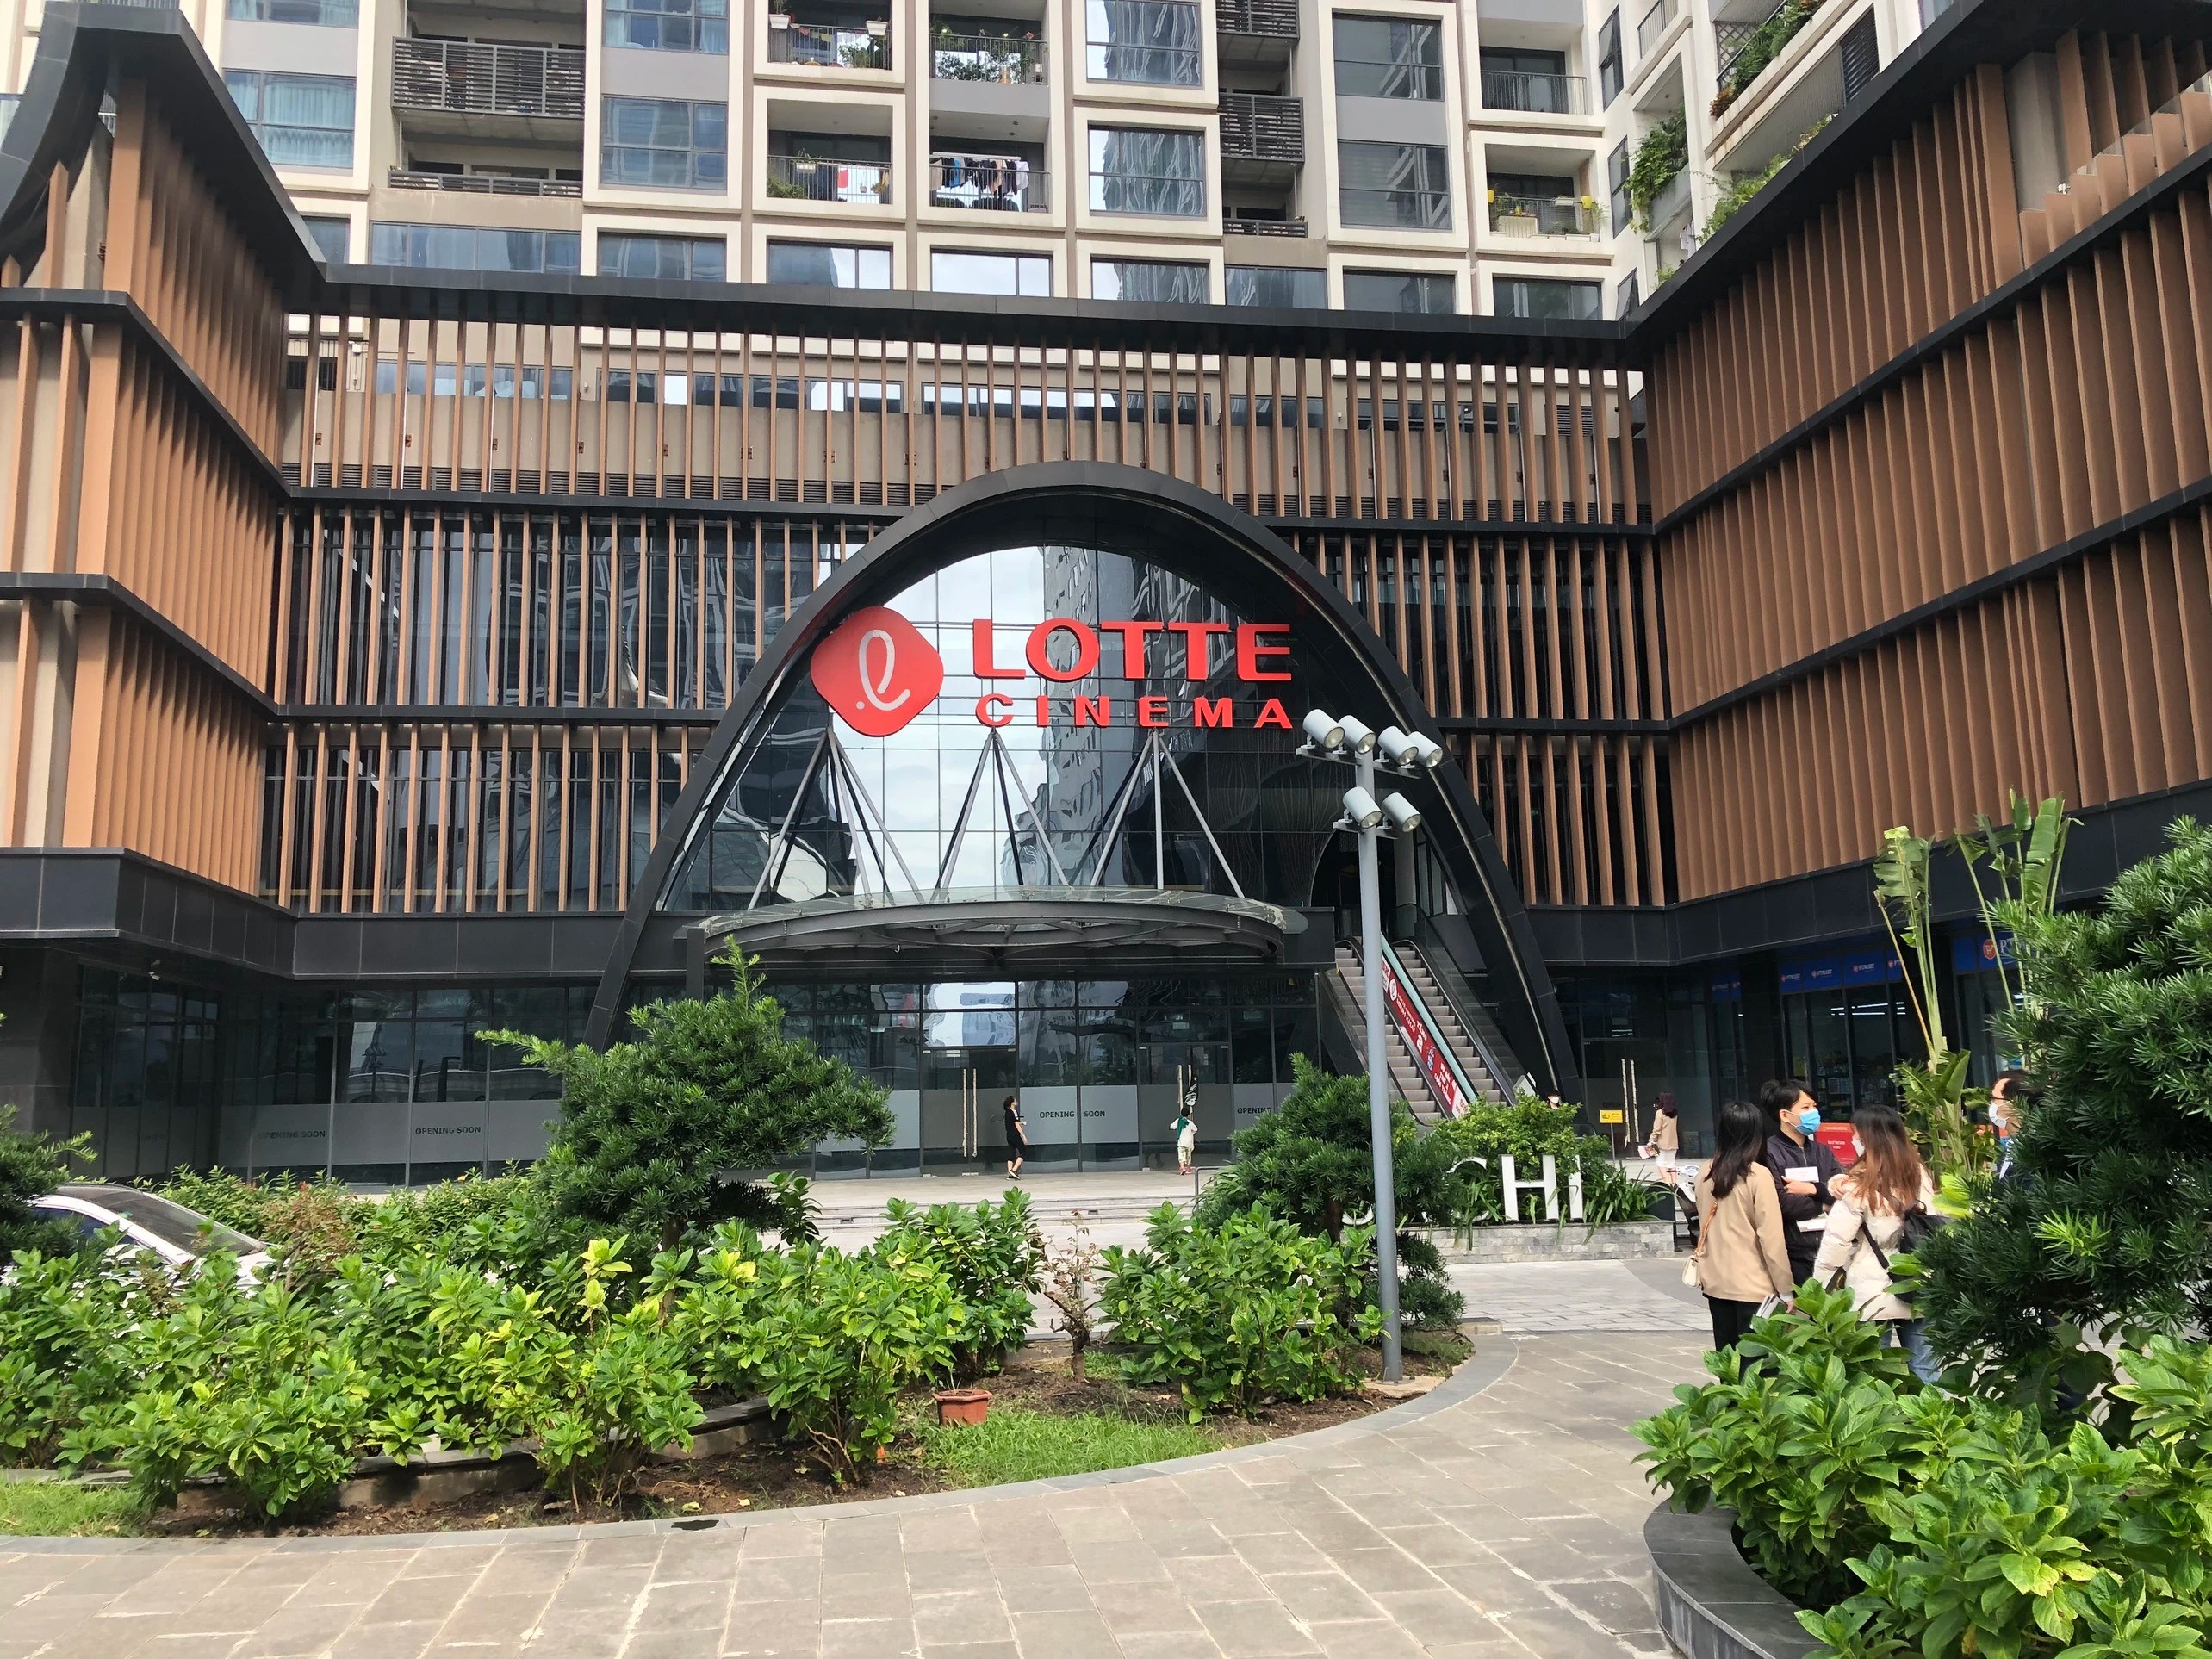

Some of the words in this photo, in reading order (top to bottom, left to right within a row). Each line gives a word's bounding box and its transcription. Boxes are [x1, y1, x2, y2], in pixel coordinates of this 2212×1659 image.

[972, 618, 1292, 682] LOTTE
[975, 693, 1293, 729] CINEMA
[1039, 1110, 1075, 1119] OPENING
[258, 1130, 299, 1139] ENING
[301, 1129, 326, 1138] SOON
[415, 1127, 455, 1135] OPENING
[457, 1126, 481, 1134] SOON
